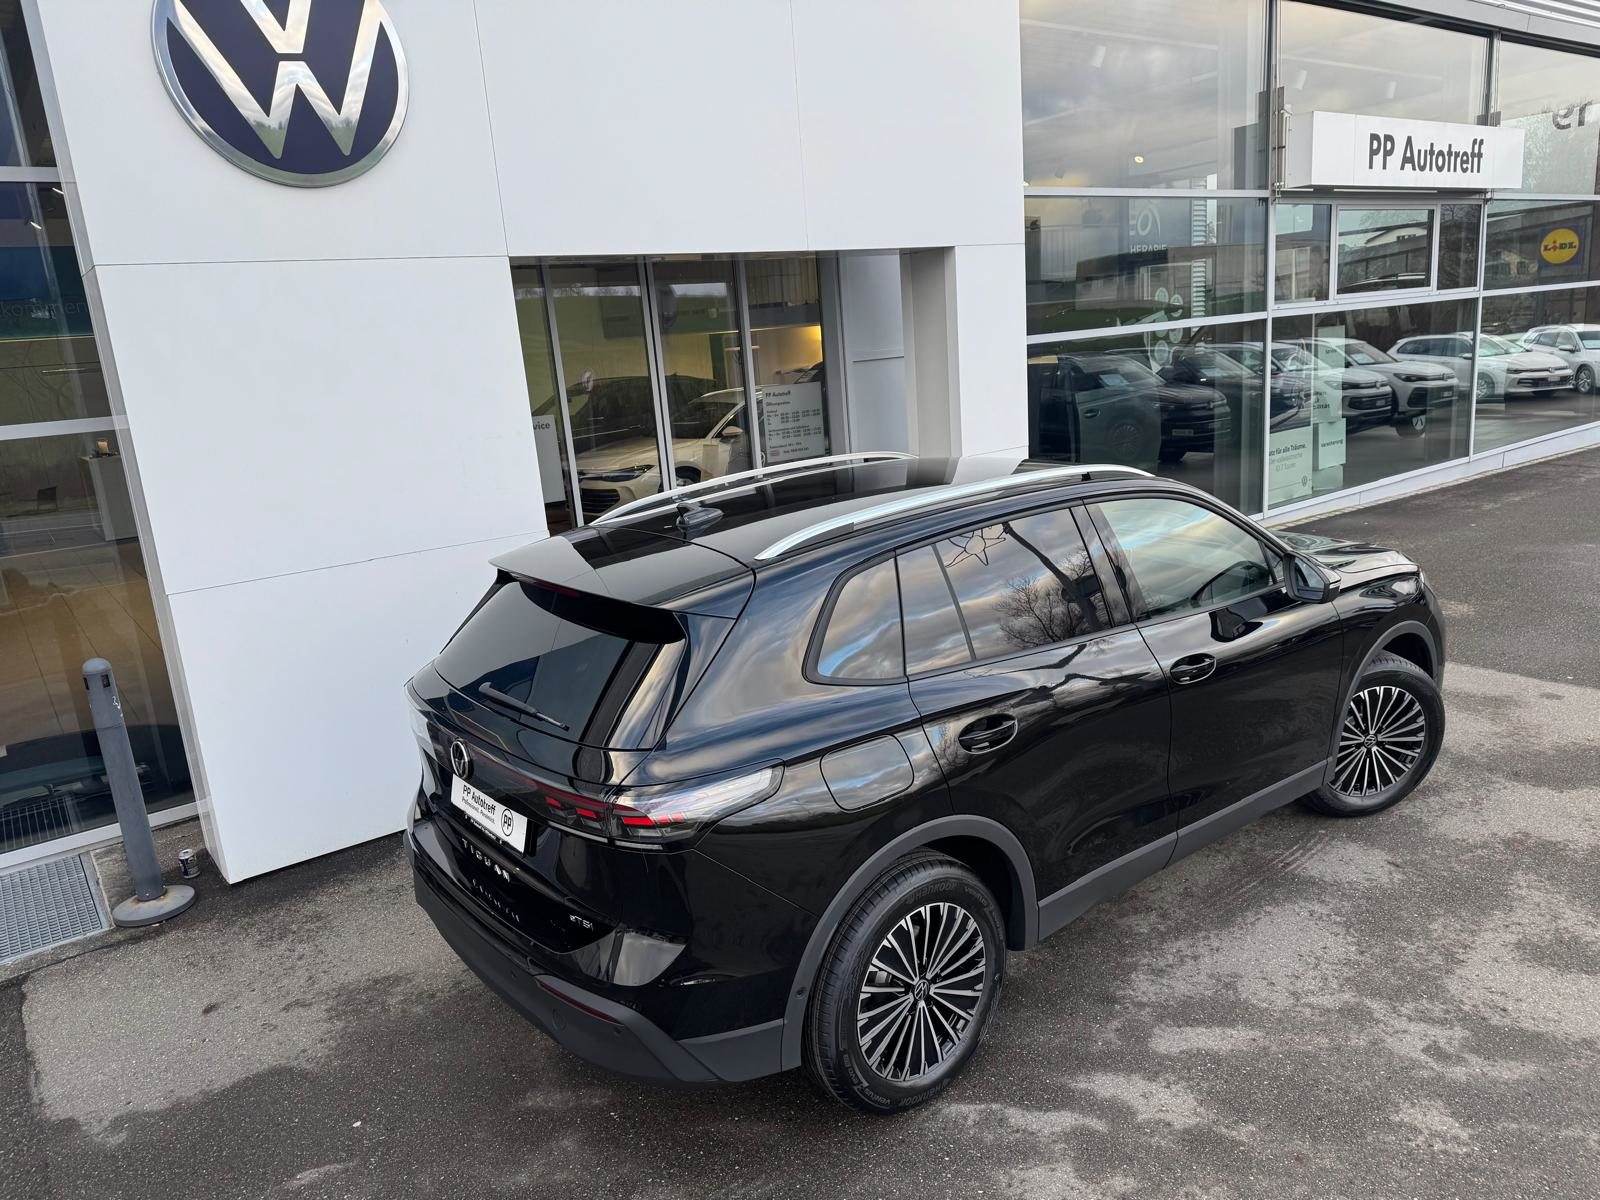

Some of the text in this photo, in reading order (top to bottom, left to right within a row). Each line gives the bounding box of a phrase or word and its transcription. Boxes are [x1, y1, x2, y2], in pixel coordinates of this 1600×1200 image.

[1368, 132, 1485, 174] PP Autotreff
[463, 785, 497, 815] PP Autotreff
